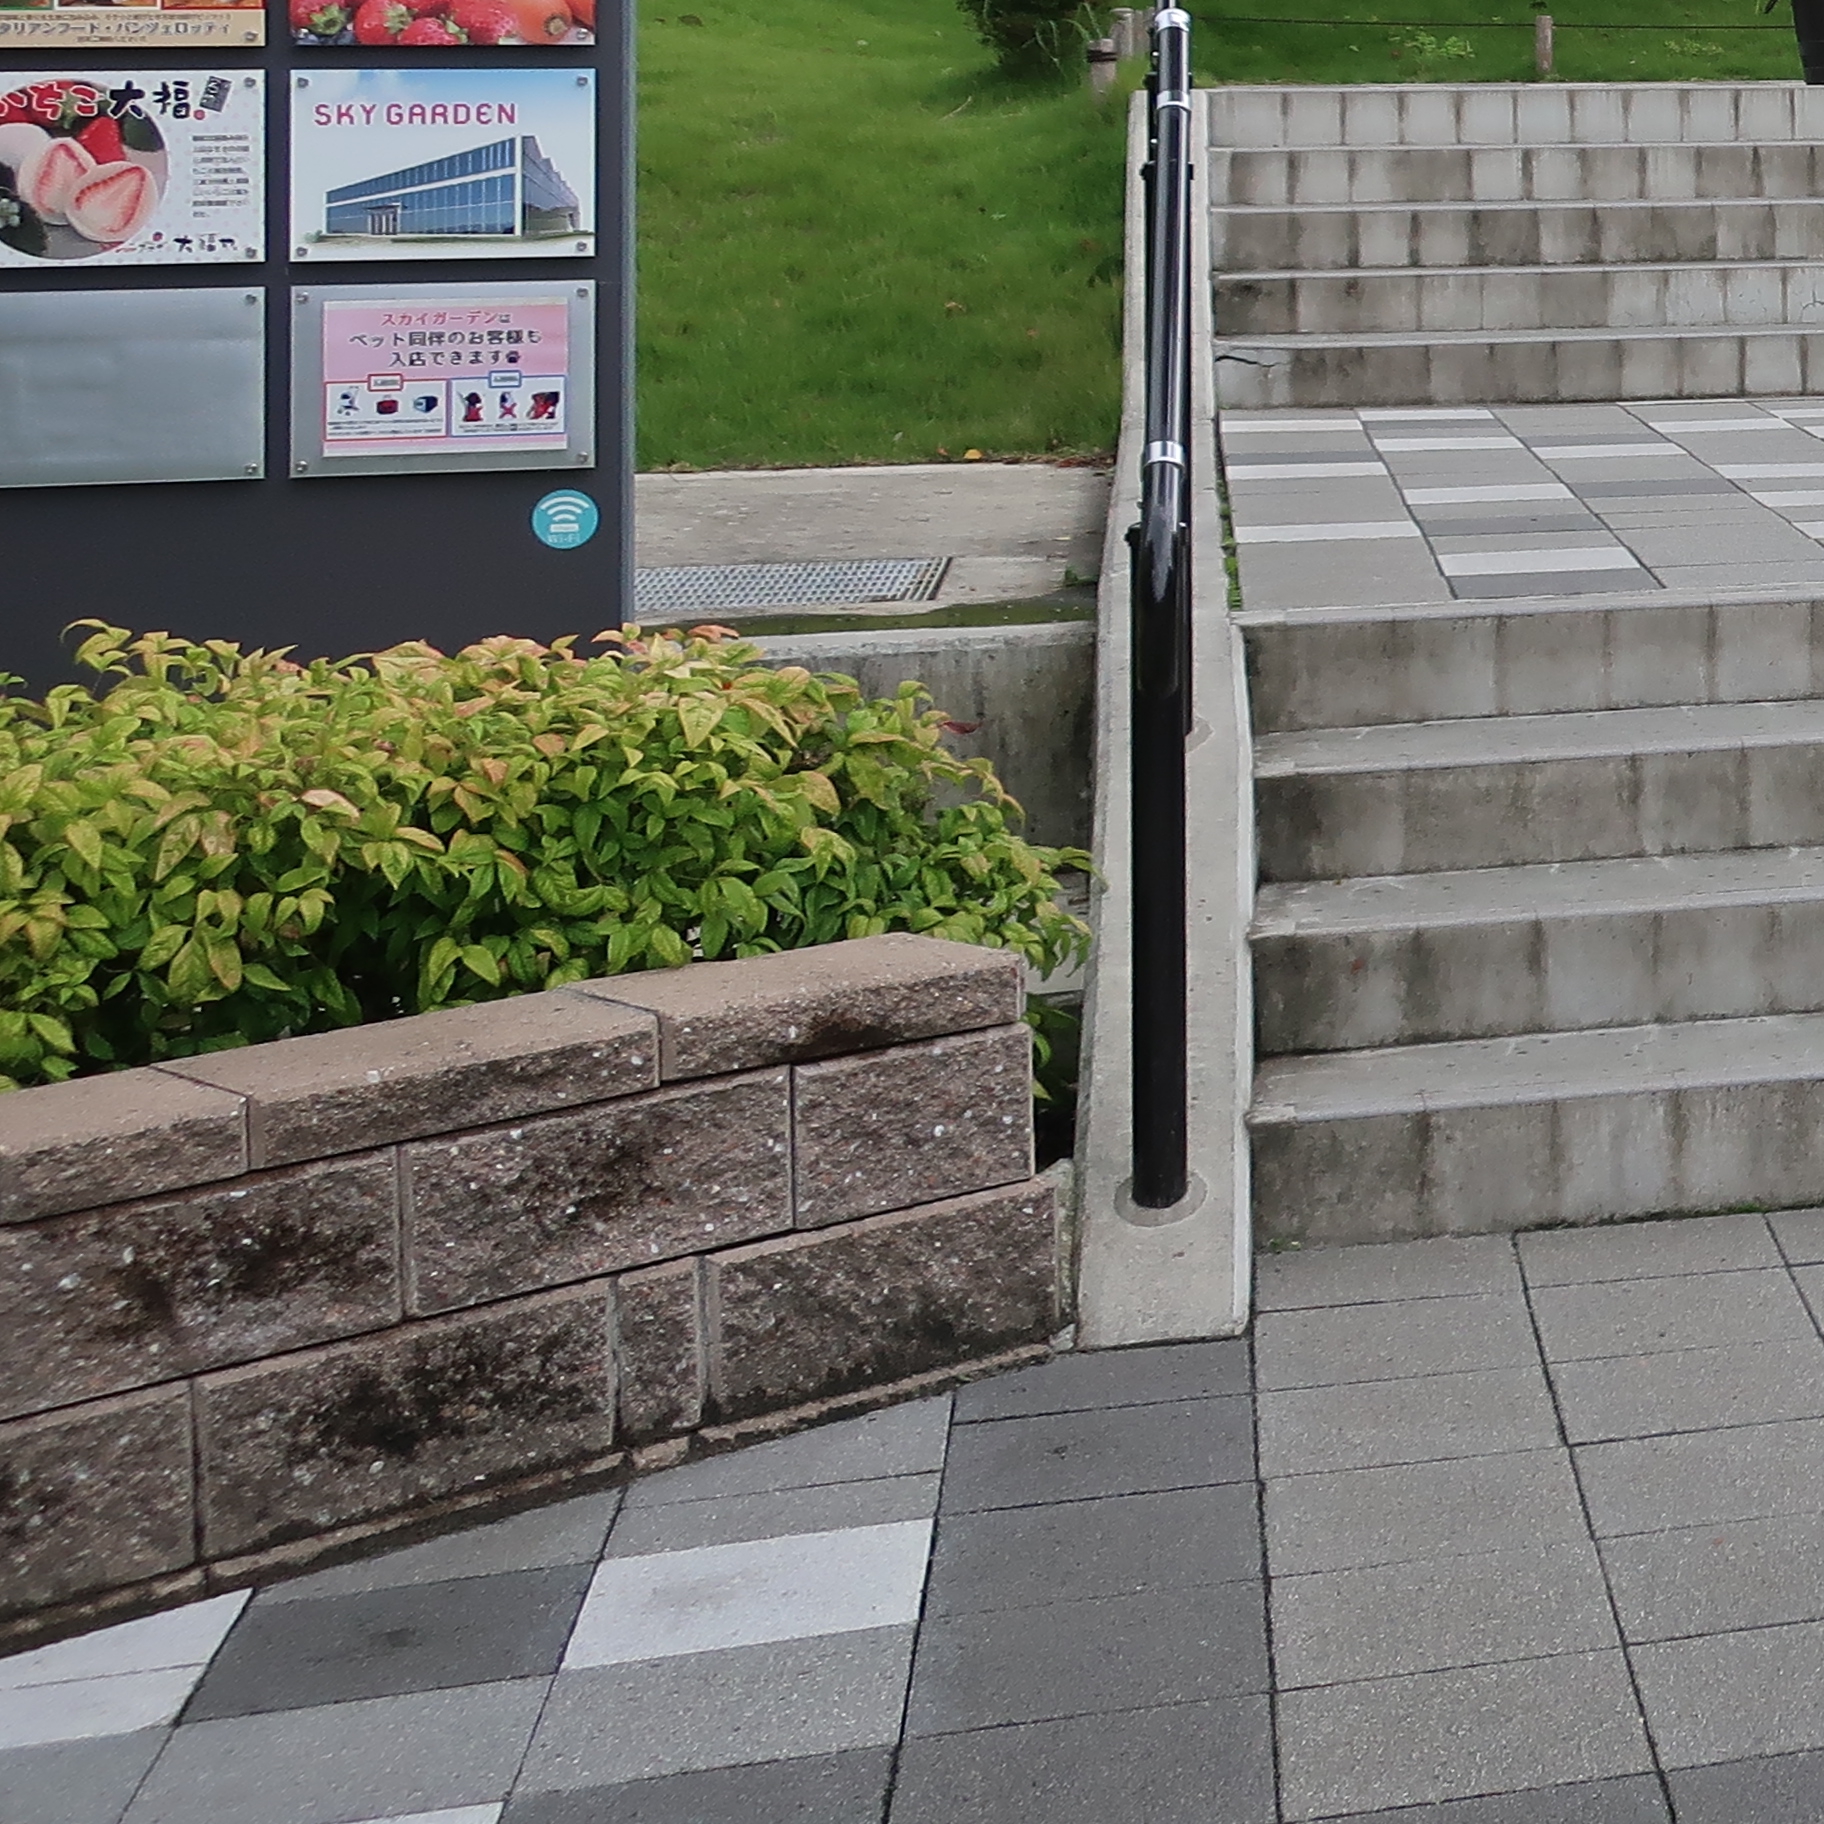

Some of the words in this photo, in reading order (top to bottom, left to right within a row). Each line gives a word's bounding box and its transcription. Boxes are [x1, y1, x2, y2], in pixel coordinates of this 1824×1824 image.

[314, 103, 376, 126] SKY
[386, 103, 517, 126] GARDEN
[381, 311, 511, 326] スカイガーデンは
[349, 329, 542, 347] ペット同伴のお客様も
[388, 350, 502, 368] 入店できます
